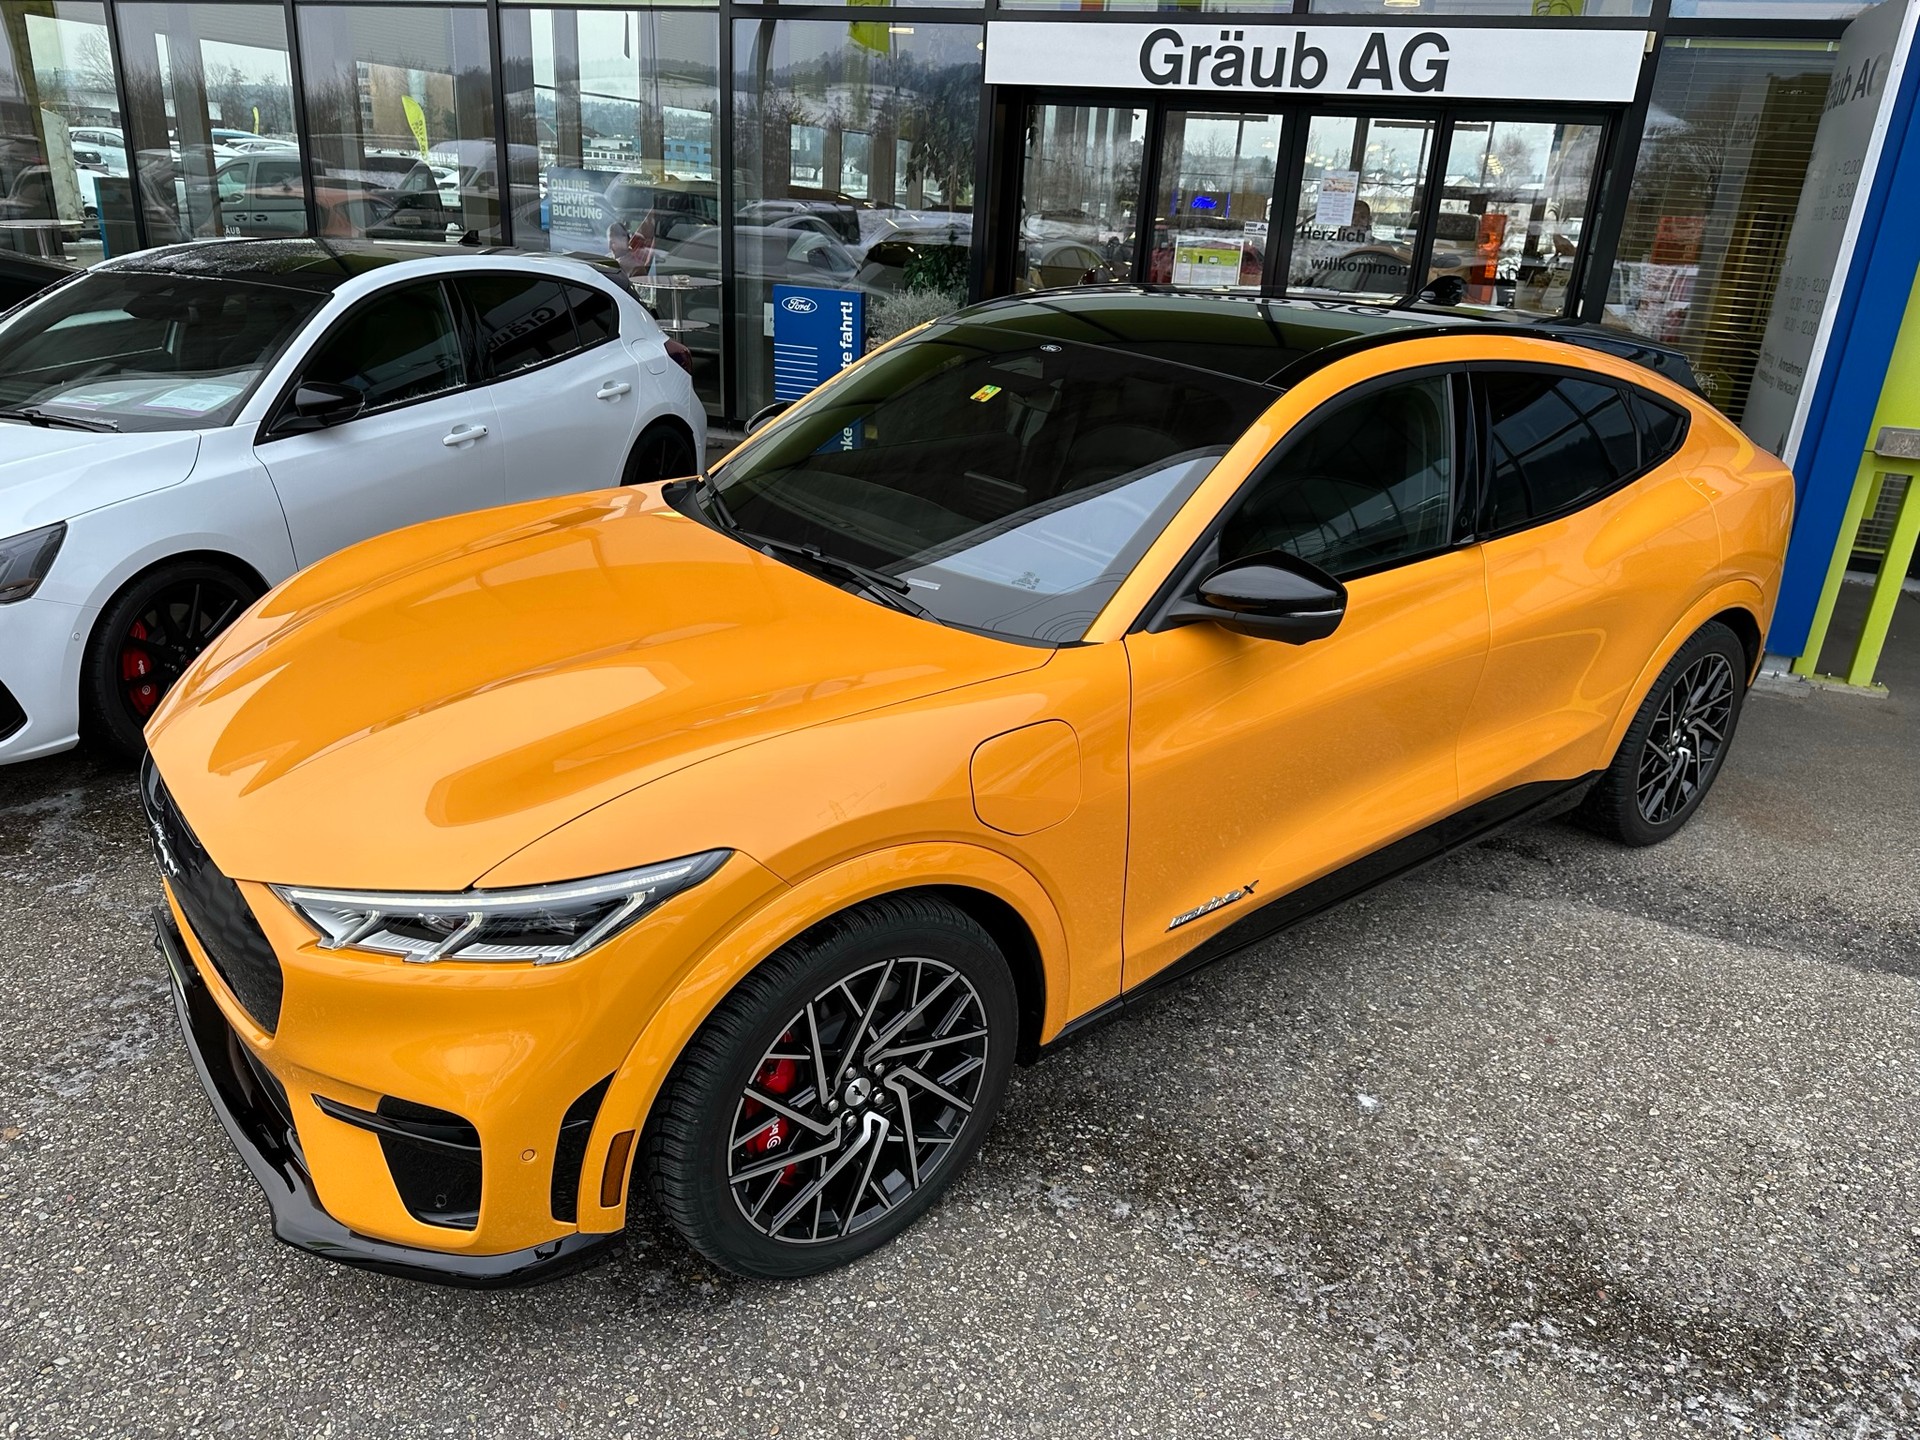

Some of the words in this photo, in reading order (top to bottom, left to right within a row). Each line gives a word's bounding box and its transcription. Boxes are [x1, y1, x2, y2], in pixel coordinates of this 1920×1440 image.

[1139, 28, 1328, 89] Gräub
[1346, 32, 1450, 92] AG
[551, 178, 590, 192] ONLINE
[552, 192, 595, 206] SERVICE
[553, 204, 603, 220] BUCHUNG
[1301, 226, 1365, 243] Herzlich
[1311, 257, 1408, 276] willkommen
[786, 298, 813, 312] Ford
[840, 301, 853, 349] fahrt!
